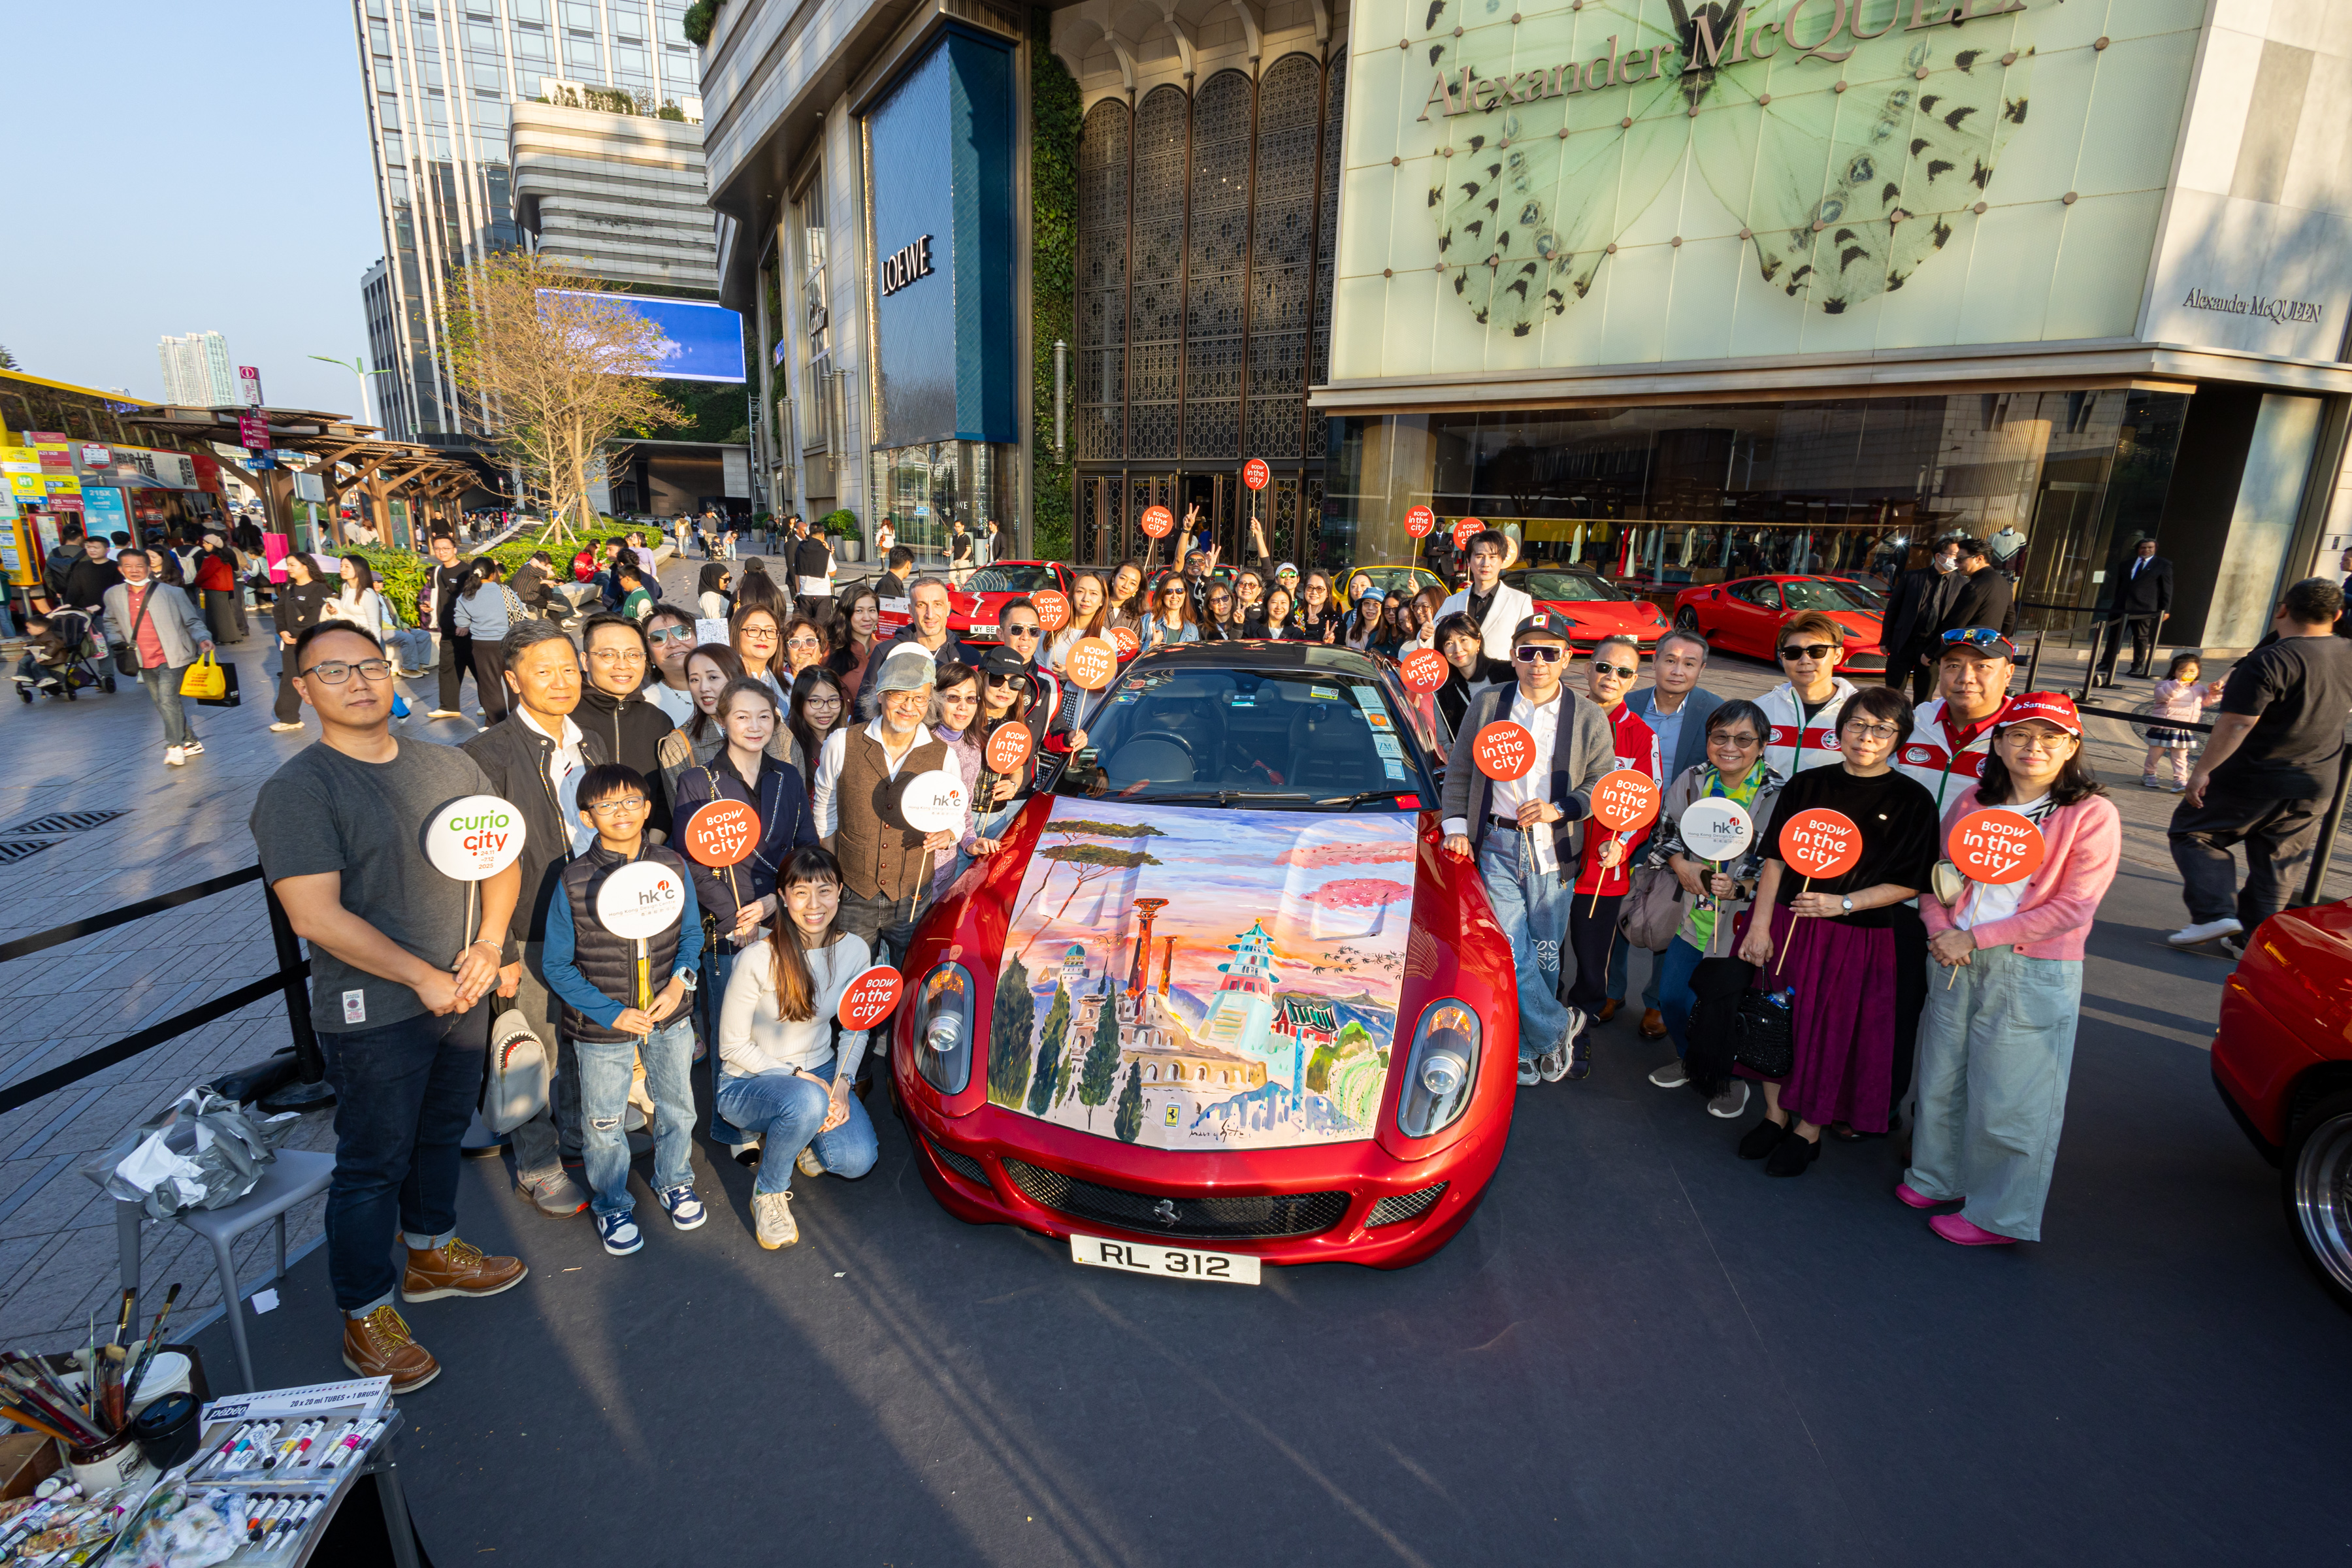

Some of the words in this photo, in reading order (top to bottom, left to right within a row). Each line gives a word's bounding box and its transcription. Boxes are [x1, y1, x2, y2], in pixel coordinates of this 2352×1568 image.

[1416, 34, 1675, 123] Alexander
[881, 235, 928, 295] LOEWE
[2183, 287, 2250, 314] Alexander
[2249, 295, 2322, 324] McQUEEN
[809, 305, 826, 336] Cartier
[18, 477, 33, 485] H1
[1249, 476, 1263, 487] city
[1149, 523, 1165, 535] city
[1154, 517, 1168, 526] the
[1411, 524, 1427, 535] city
[1035, 605, 1044, 613] in
[1046, 604, 1062, 613] the
[1040, 613, 1062, 627] city
[1118, 640, 1132, 653] the
[1119, 632, 1136, 645] BODW
[1084, 645, 1110, 657] BODW
[1411, 652, 1434, 666] BODW
[1074, 651, 1085, 665] in
[1087, 654, 1108, 669] the
[1077, 667, 1105, 685] city
[1407, 670, 1418, 679] in
[1418, 661, 1439, 674] the
[1416, 670, 1439, 687] city
[2023, 701, 2071, 716] Santander
[1005, 731, 1028, 741] BODW
[1488, 728, 1519, 743] BODW
[996, 738, 1005, 750] in
[1007, 740, 1024, 753] the
[1378, 742, 1399, 751] ZMA
[1481, 745, 1496, 759] in
[1496, 740, 1524, 755] the
[997, 751, 1020, 769] city
[1492, 754, 1525, 774] city
[1616, 779, 1652, 794] BODW
[1602, 786, 1618, 801] in
[1620, 790, 1648, 809] the
[449, 810, 510, 831] curio
[706, 808, 744, 826] BODW
[1605, 804, 1642, 826] city
[697, 830, 715, 843] in
[716, 821, 747, 838] the
[1809, 819, 1852, 836] BODW
[1980, 821, 2033, 838] BODW
[709, 835, 747, 858] city
[1792, 826, 1810, 843] in
[1813, 832, 1847, 853] the
[1963, 828, 1984, 846] in
[1987, 834, 2027, 856] the
[1797, 846, 1840, 872] city
[1968, 850, 2021, 877] city
[866, 979, 898, 988] BODW
[851, 989, 866, 1003] in
[868, 988, 892, 1002] the
[853, 1003, 886, 1024] city
[1100, 1242, 1150, 1269] RL
[1165, 1252, 1230, 1277] 312
[324, 1394, 345, 1403] TUBES
[357, 1390, 380, 1399] BRUSH
